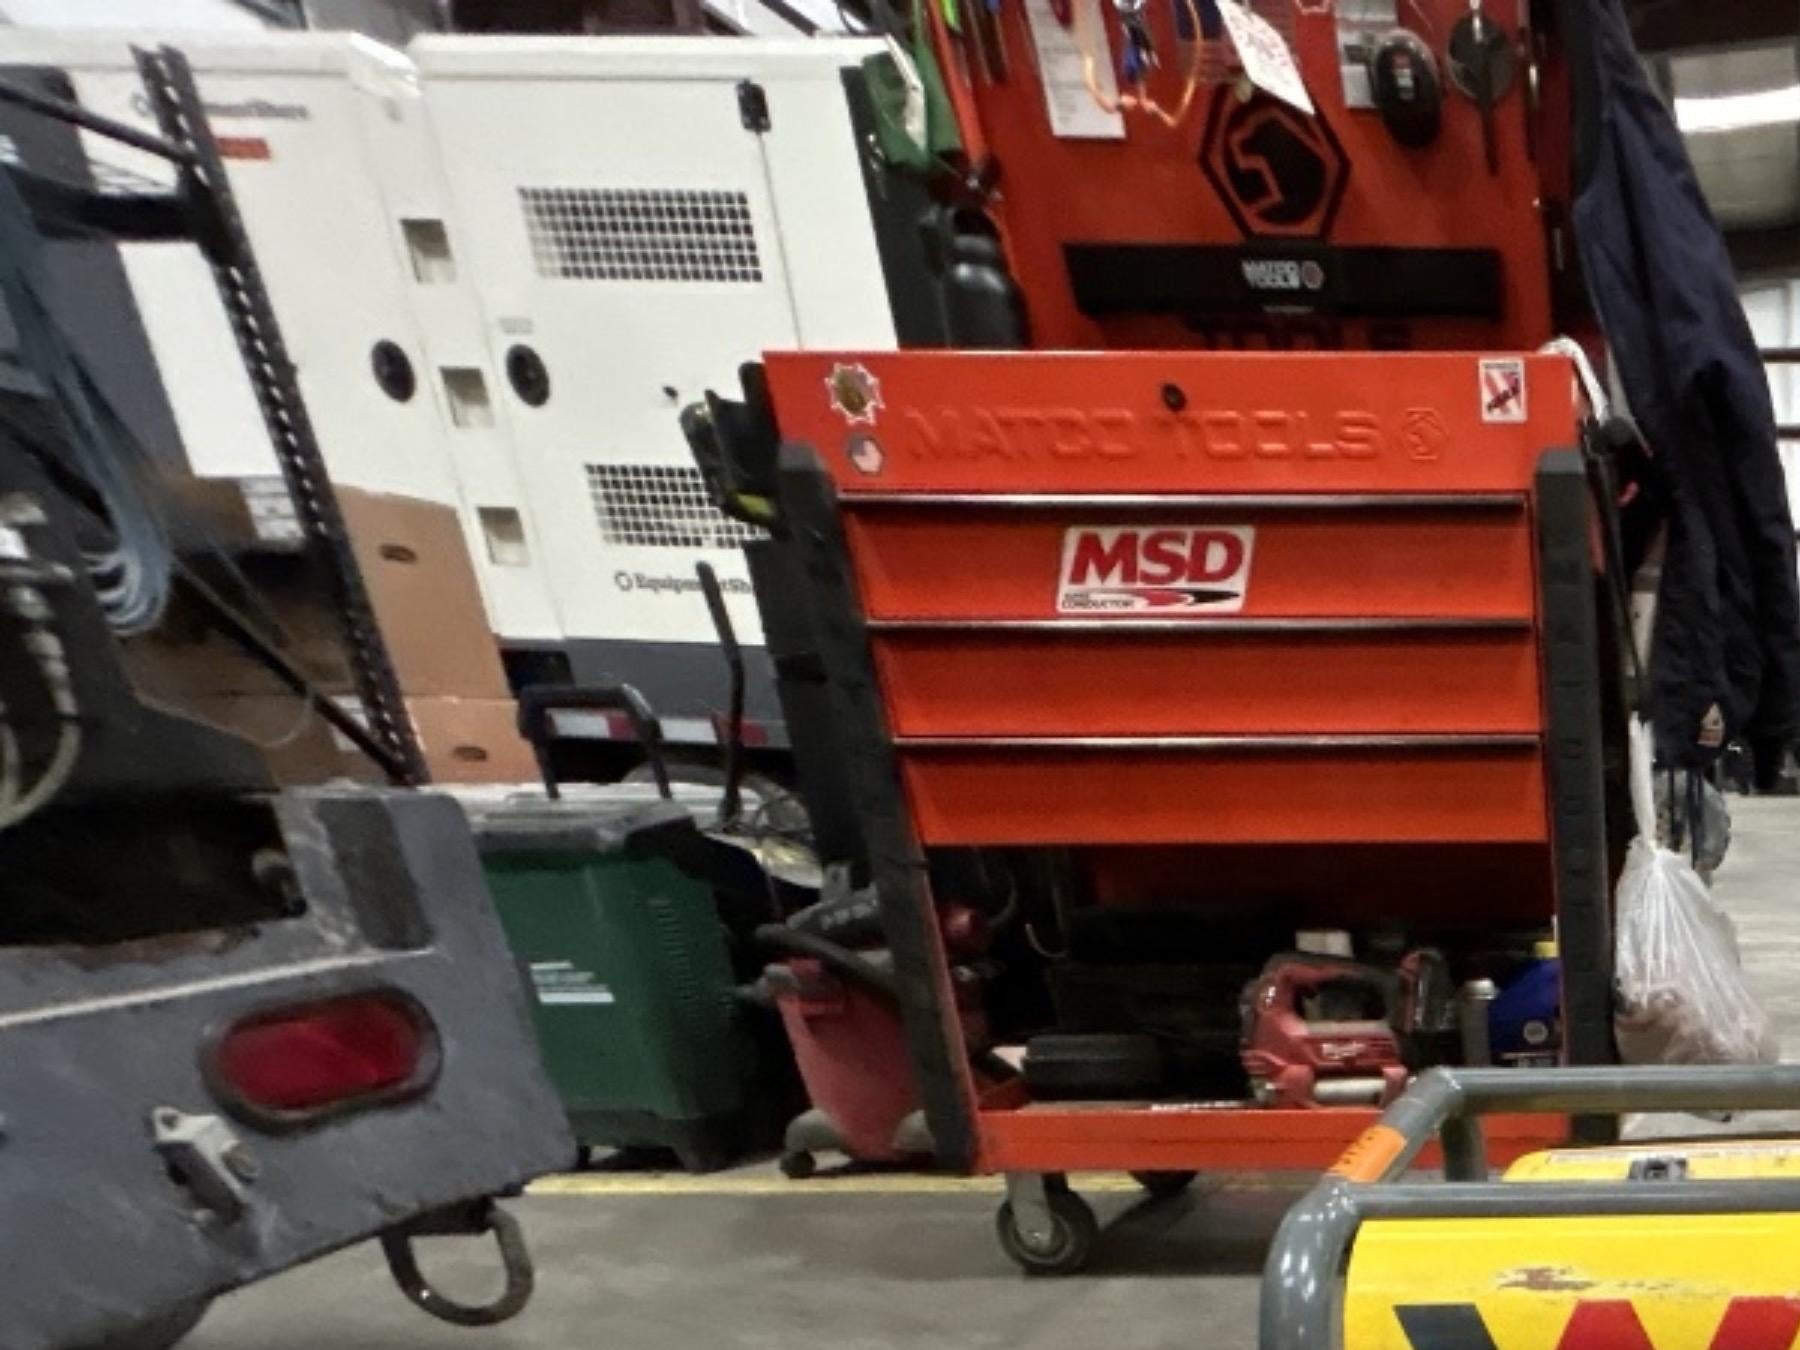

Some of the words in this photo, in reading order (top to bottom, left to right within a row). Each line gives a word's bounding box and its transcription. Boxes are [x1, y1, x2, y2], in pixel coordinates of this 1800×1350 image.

[905, 408, 1138, 460] MATCO
[1154, 407, 1381, 460] TOOLS
[1068, 530, 1244, 585] MSD
